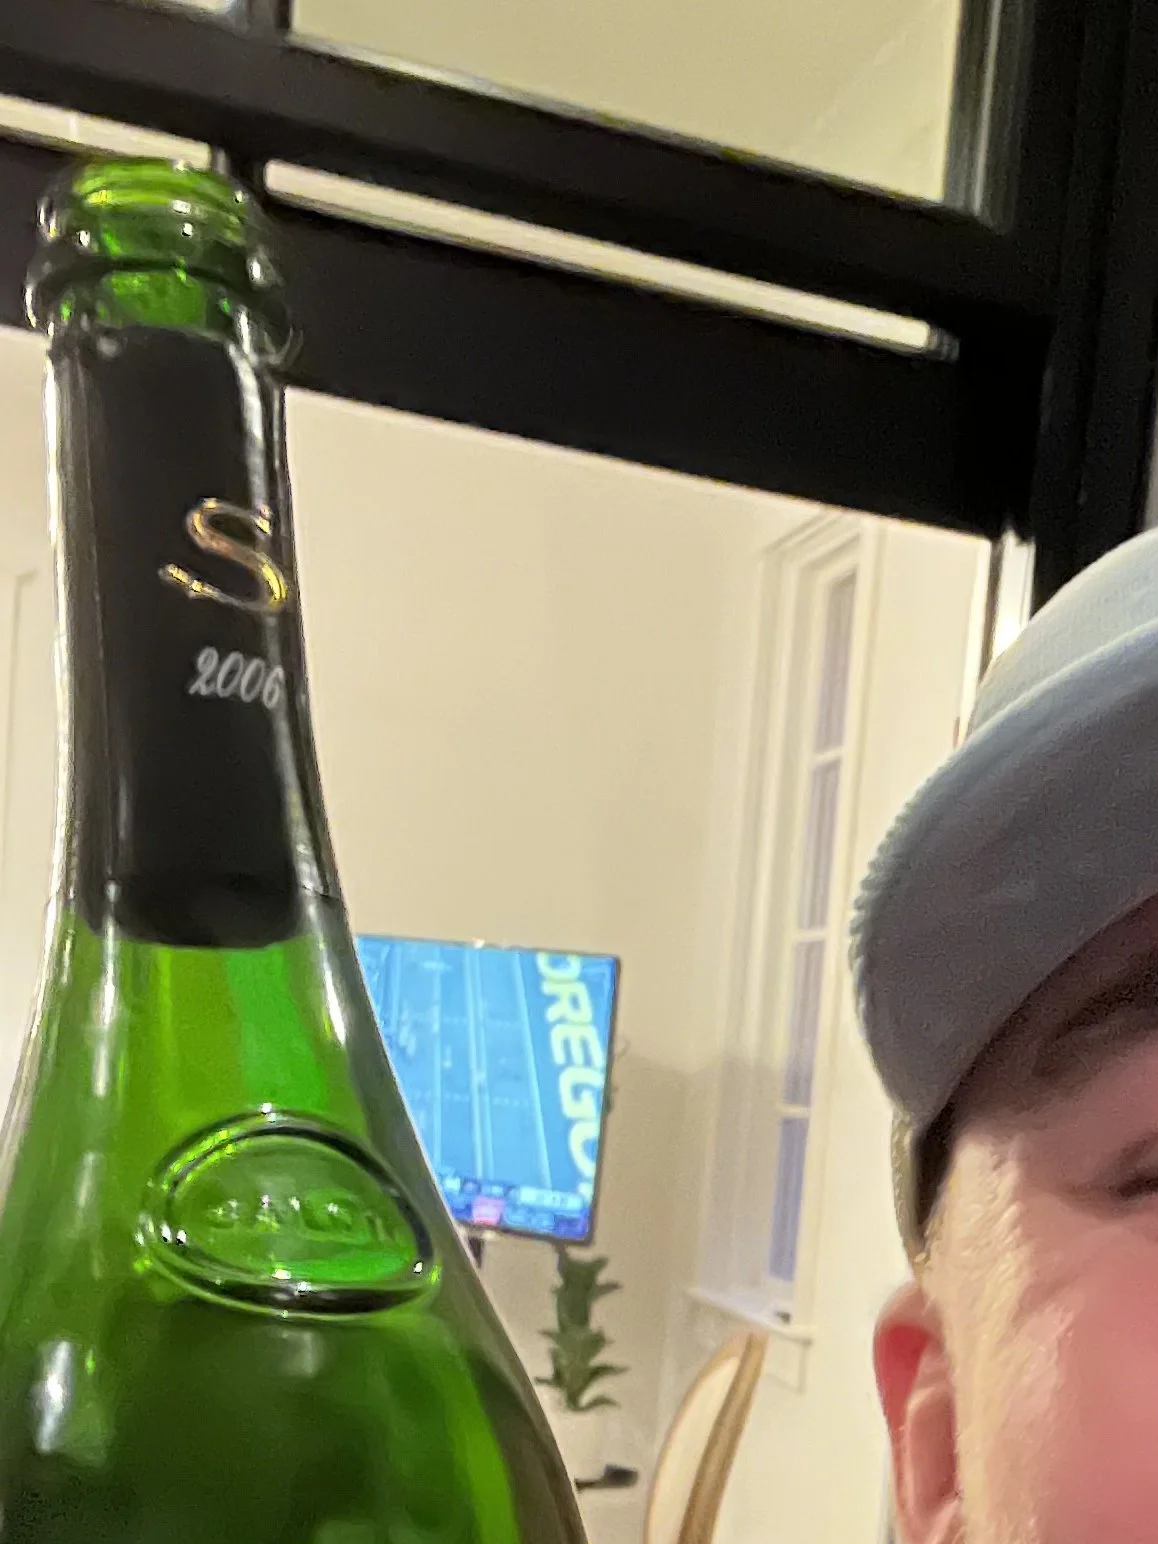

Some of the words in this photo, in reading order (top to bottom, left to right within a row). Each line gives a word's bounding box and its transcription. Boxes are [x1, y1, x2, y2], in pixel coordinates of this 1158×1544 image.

[157, 497, 288, 613] S
[188, 646, 285, 709] 2006
[536, 951, 606, 1202] OREGO
